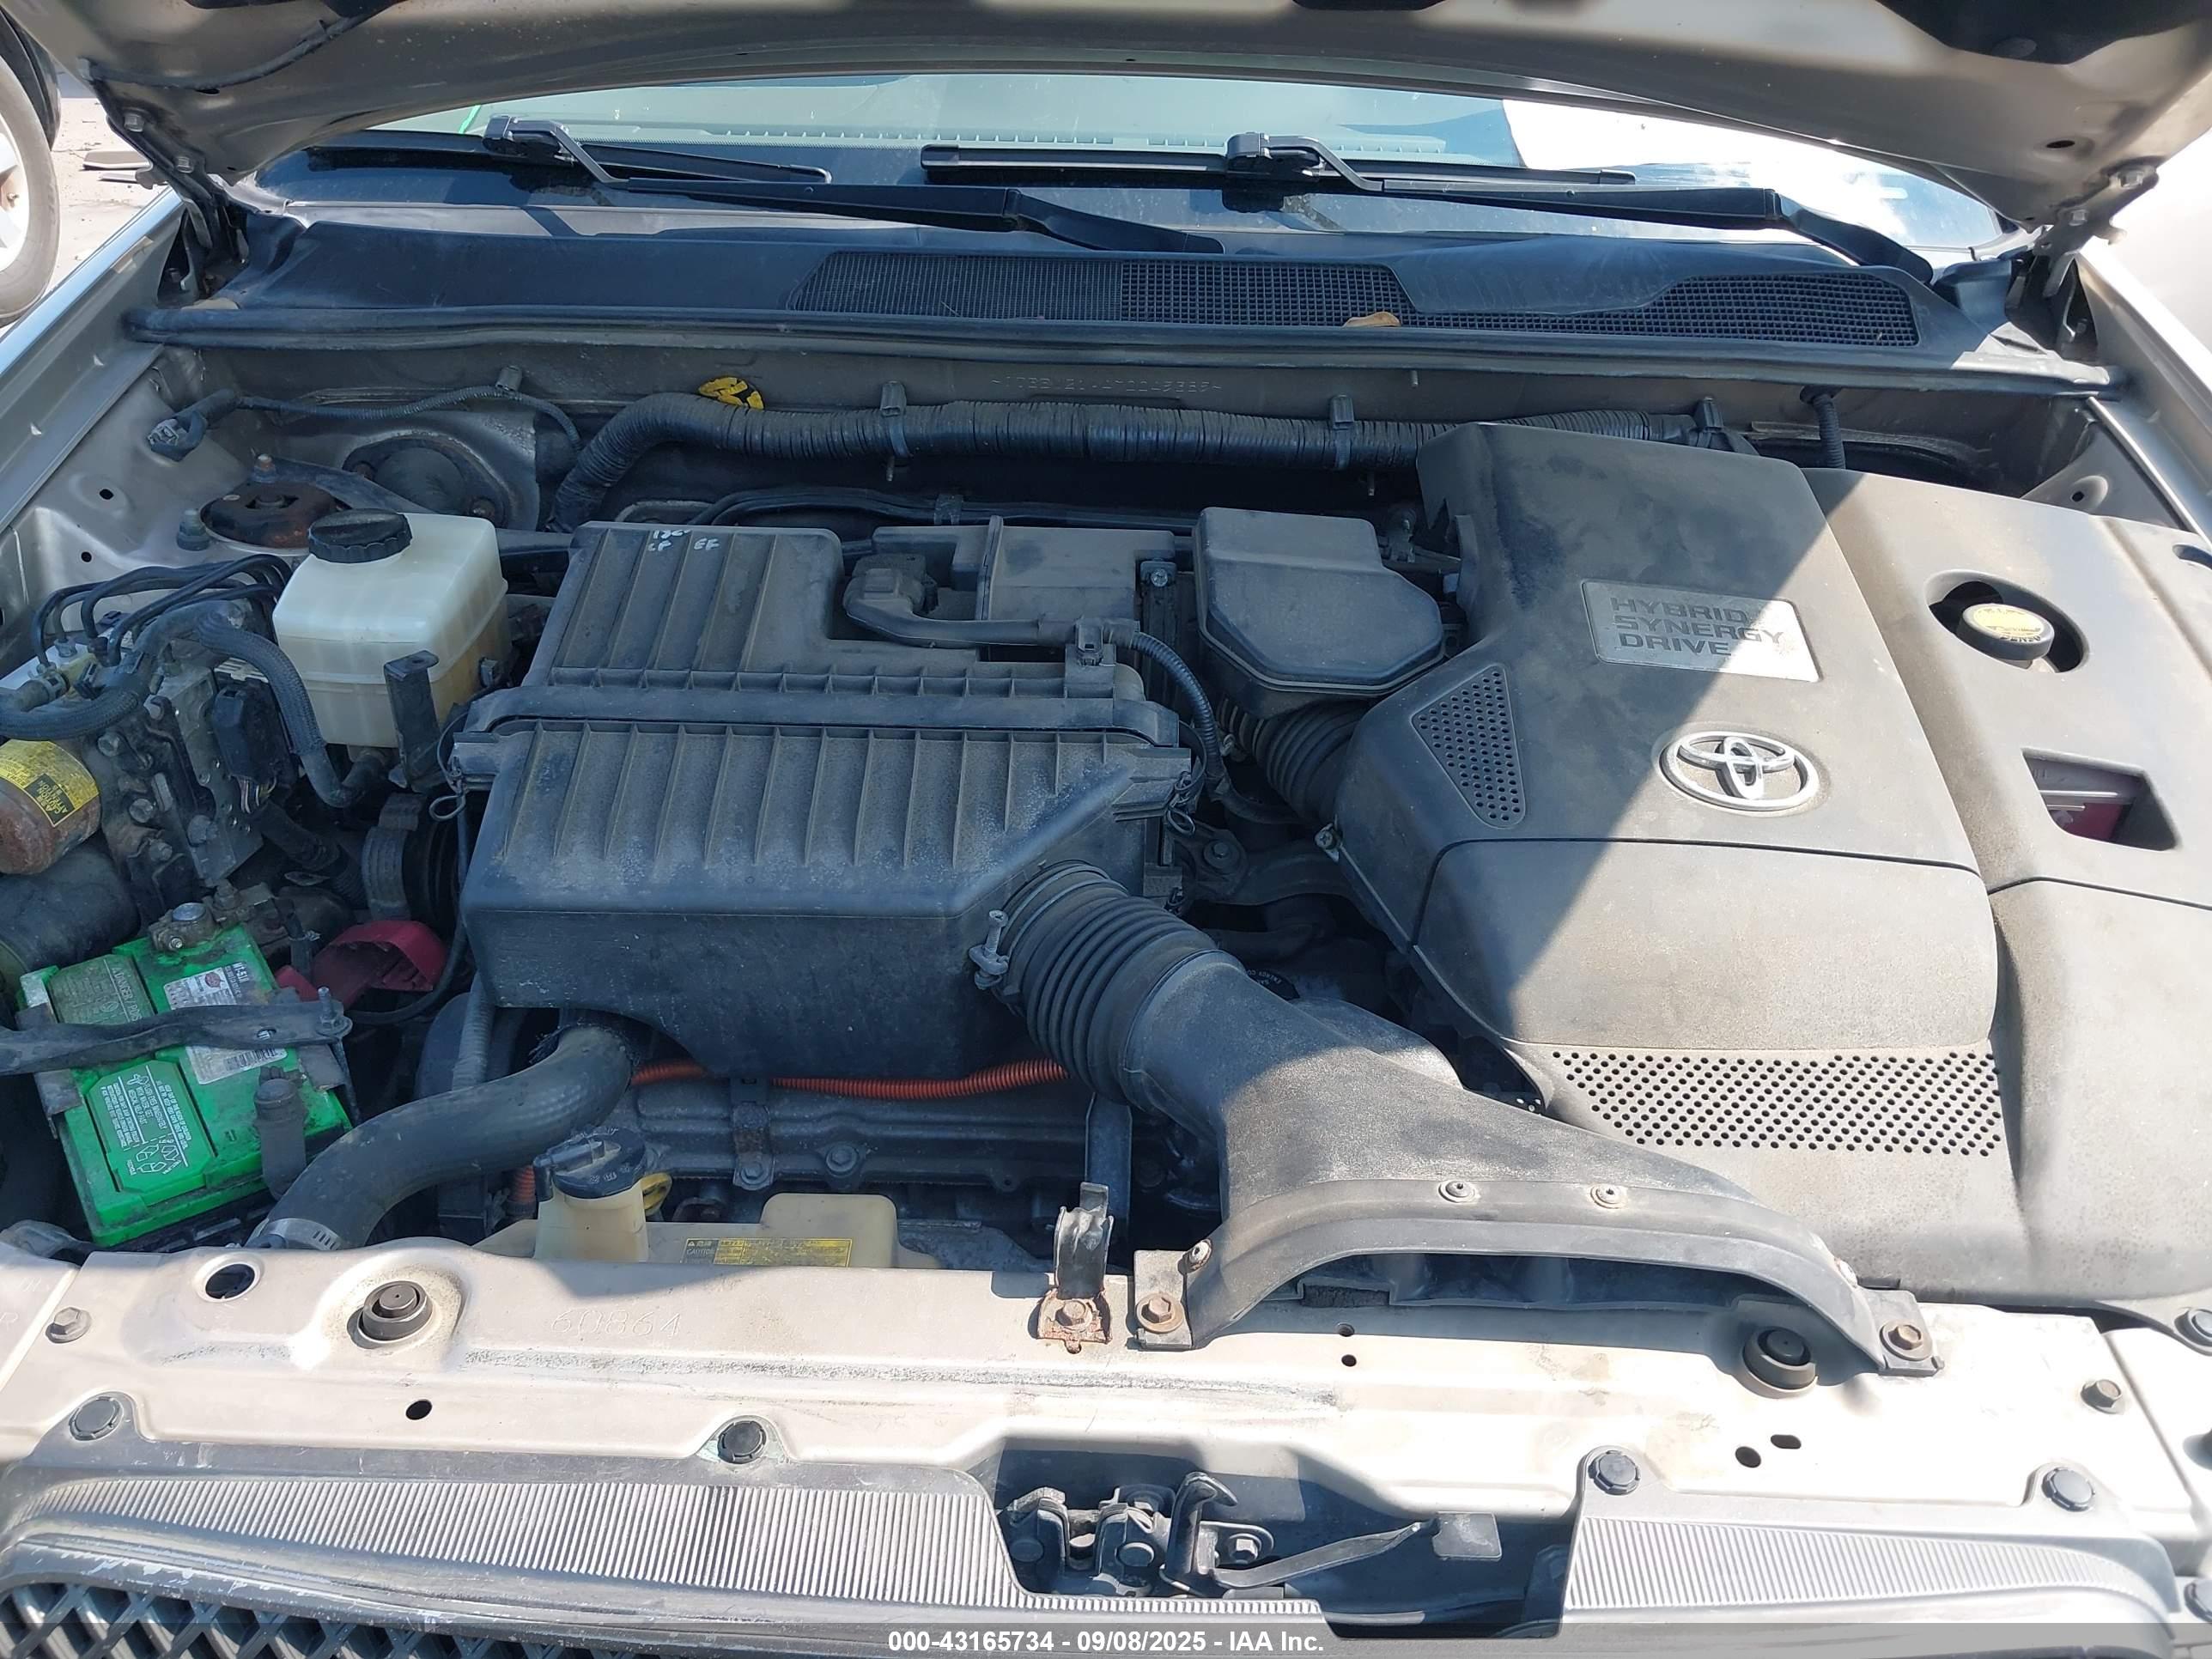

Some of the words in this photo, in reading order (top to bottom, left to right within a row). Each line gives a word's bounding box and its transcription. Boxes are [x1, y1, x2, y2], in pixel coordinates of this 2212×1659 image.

[1610, 597, 1748, 623] HYBRID
[1613, 615, 1784, 645] SYNERGY
[1619, 633, 1732, 656] DRIVE
[37, 787, 61, 813] CAUTION
[39, 780, 69, 813] ATTENTION
